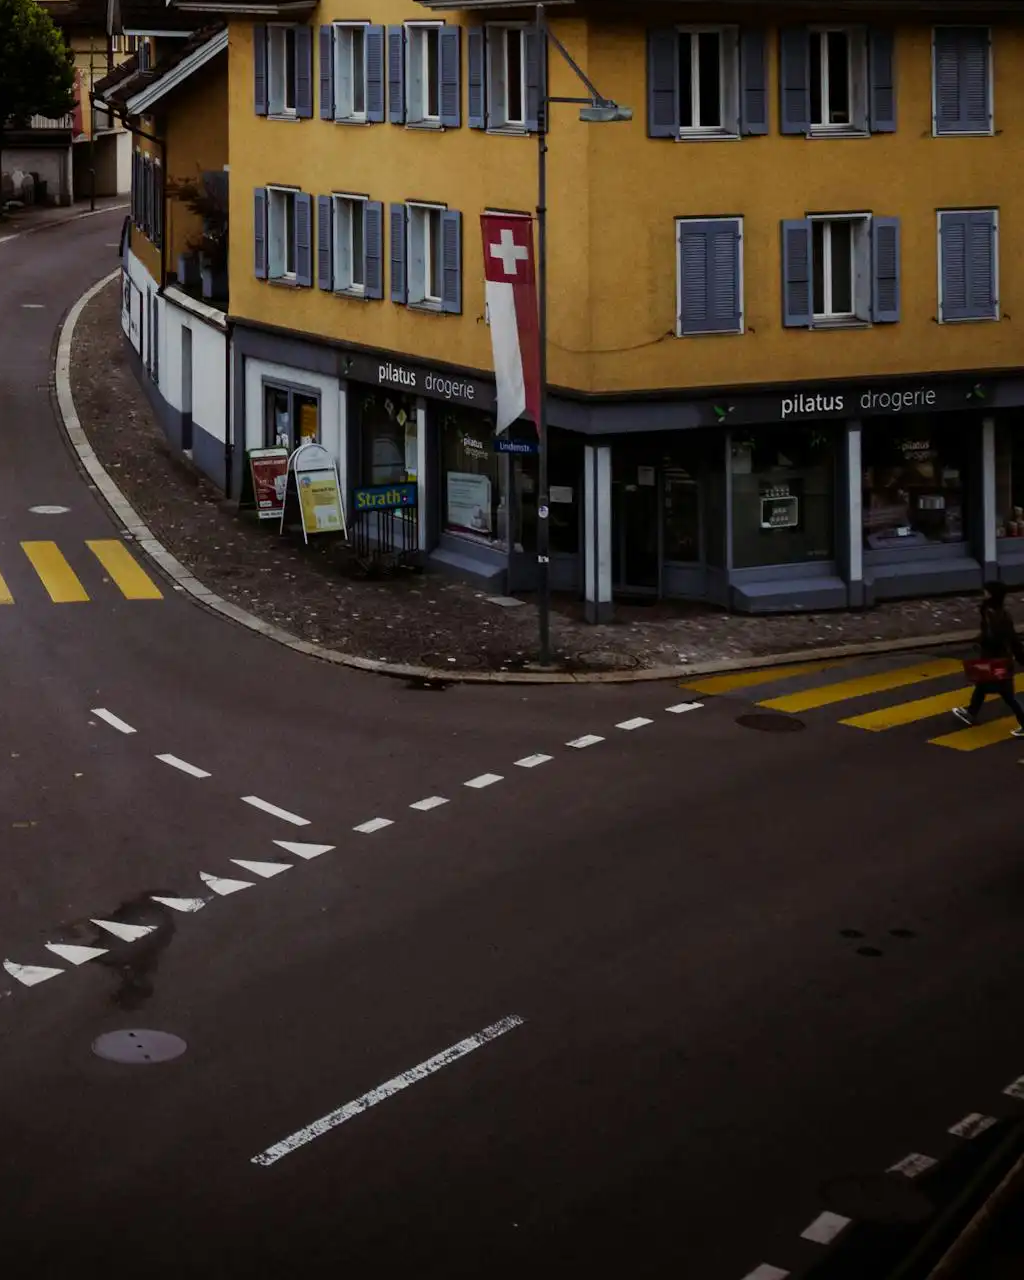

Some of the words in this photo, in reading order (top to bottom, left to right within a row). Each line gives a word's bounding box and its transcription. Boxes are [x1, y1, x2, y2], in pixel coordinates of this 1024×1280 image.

[378, 362, 416, 387] pilatus
[424, 371, 475, 400] drogerie
[780, 393, 844, 419] pilatus
[859, 386, 936, 412] drogerie
[499, 440, 533, 454] Lindenstr.
[357, 489, 401, 508] Strath
